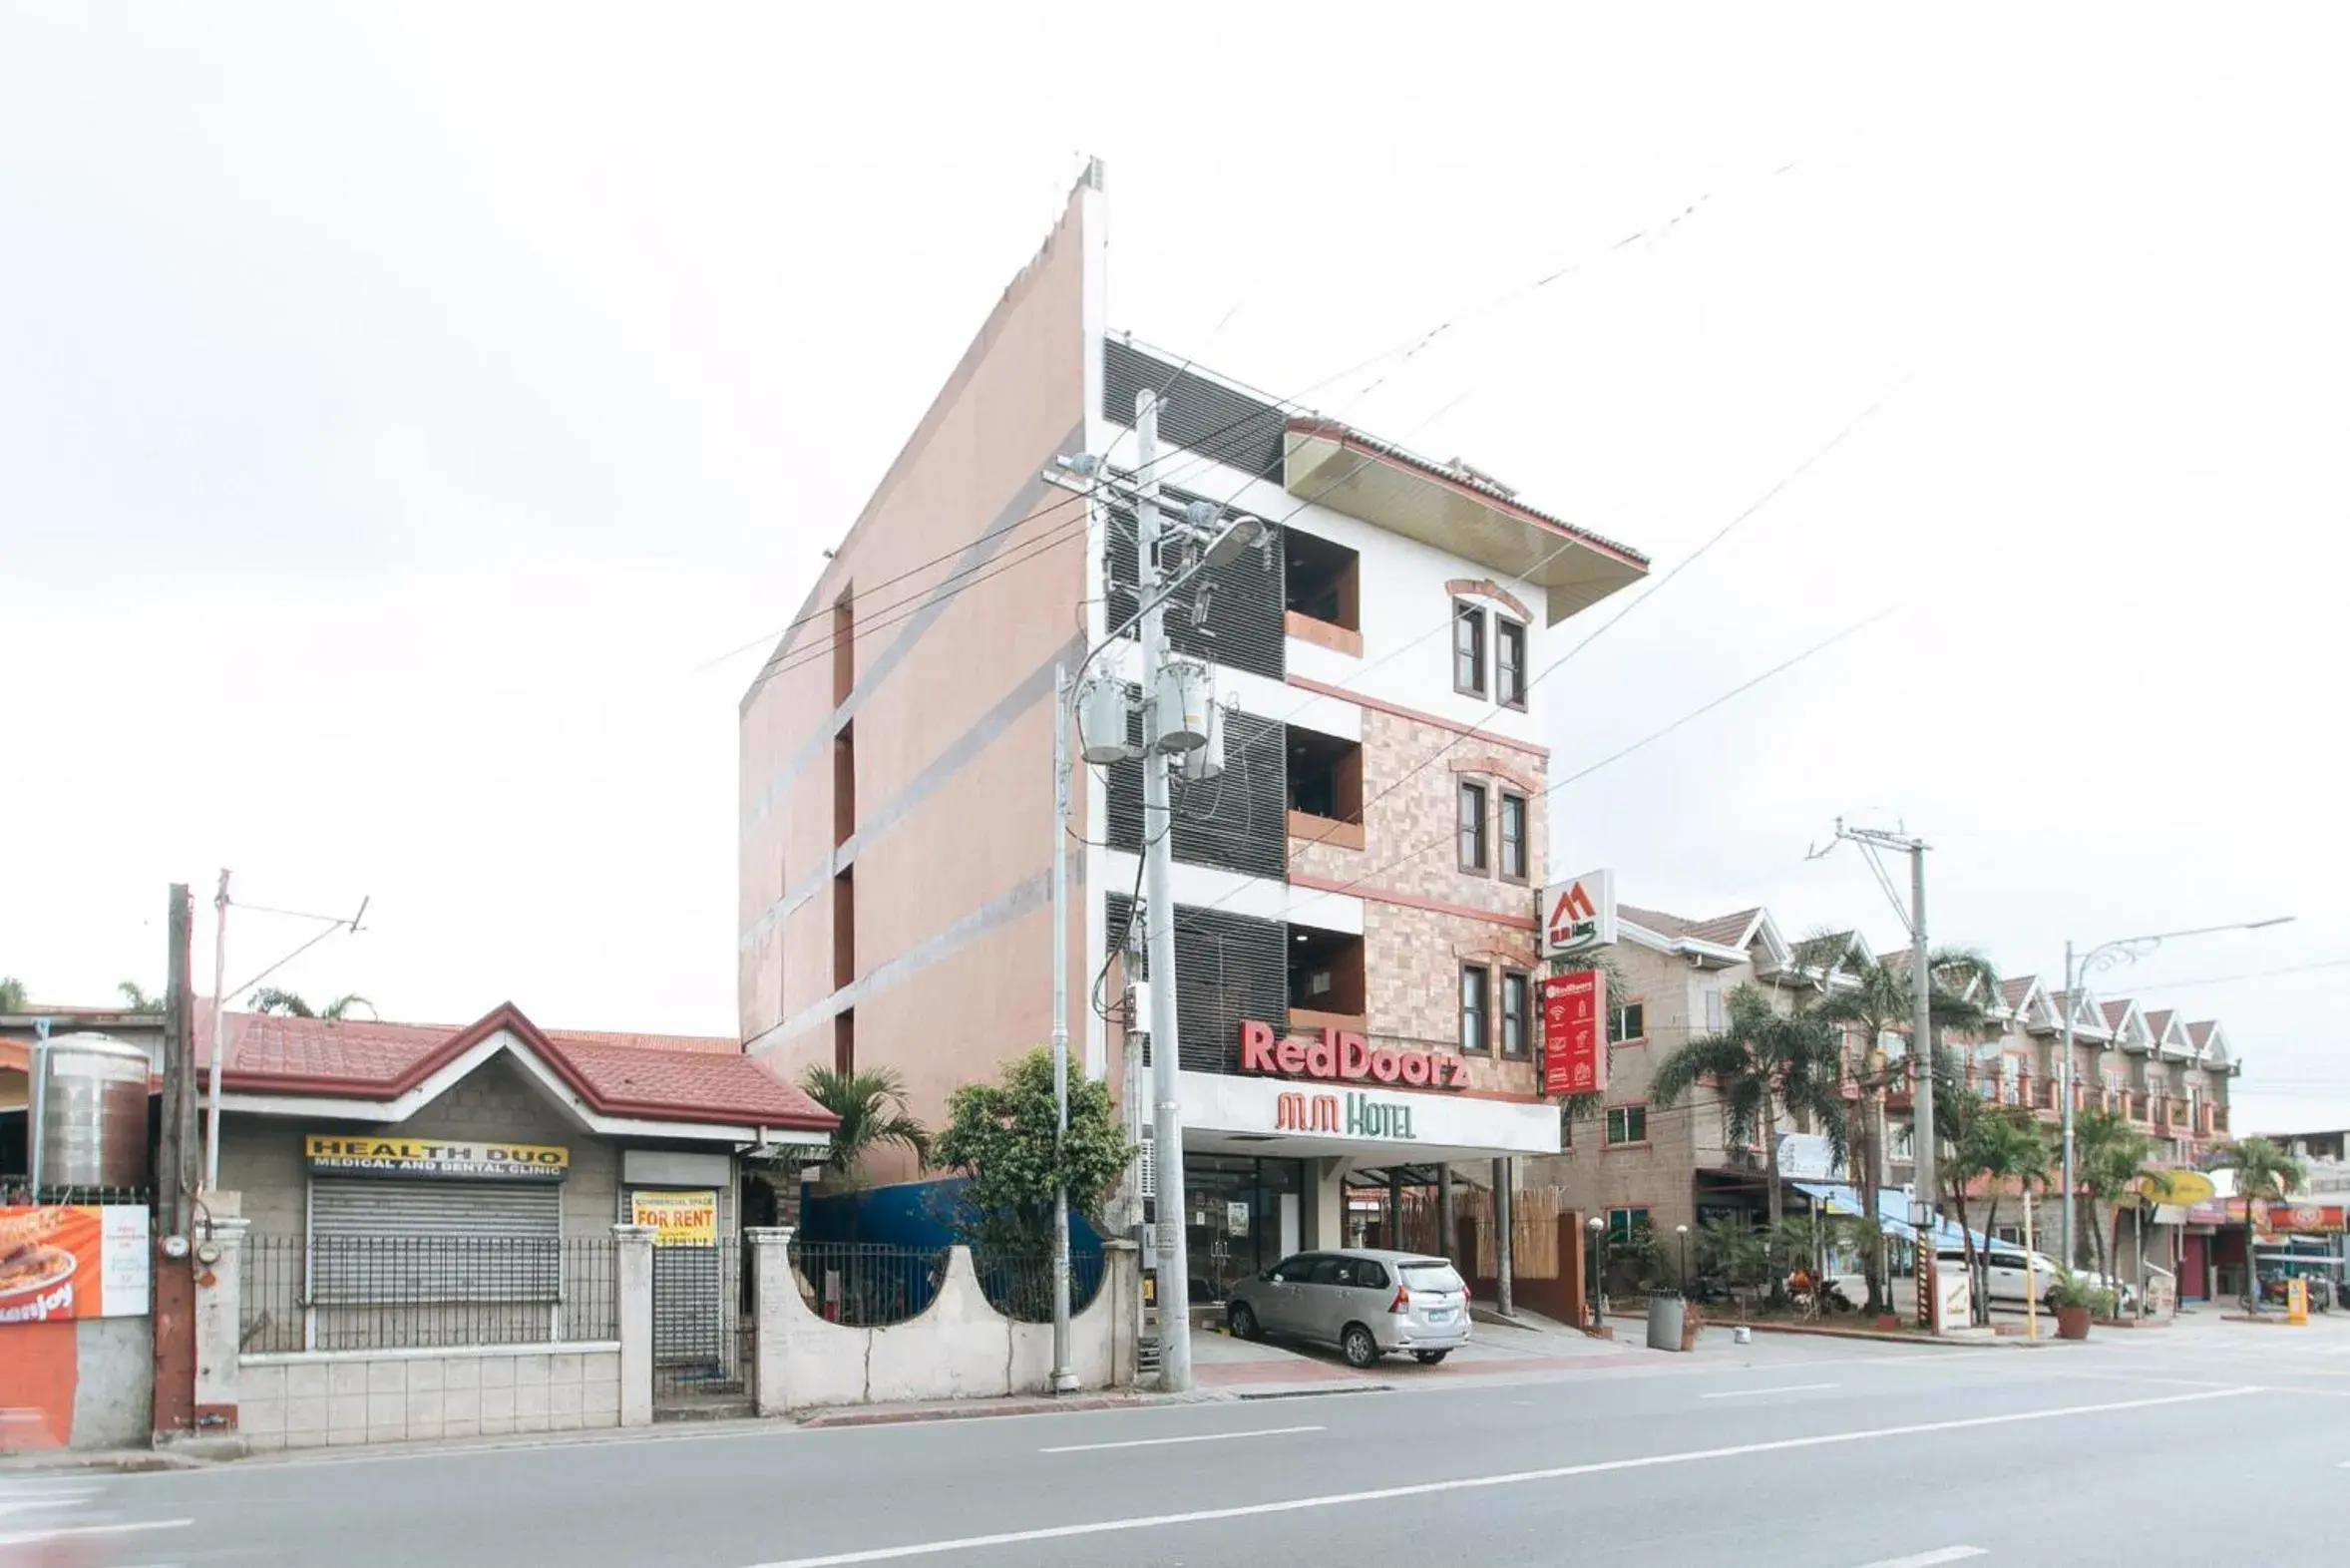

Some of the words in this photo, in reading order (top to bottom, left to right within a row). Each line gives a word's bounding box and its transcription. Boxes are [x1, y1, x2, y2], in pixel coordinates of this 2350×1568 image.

[1239, 1018, 1472, 1089] RedDoorz
[312, 1140, 473, 1160] HEALTH
[486, 1149, 562, 1164] DUO
[313, 1157, 396, 1169] MEDICAL
[398, 1159, 436, 1171] AND
[440, 1161, 504, 1174] DENTAL
[508, 1163, 562, 1175] CLINIC
[637, 1210, 668, 1228] FOR
[673, 1209, 713, 1227] RENT
